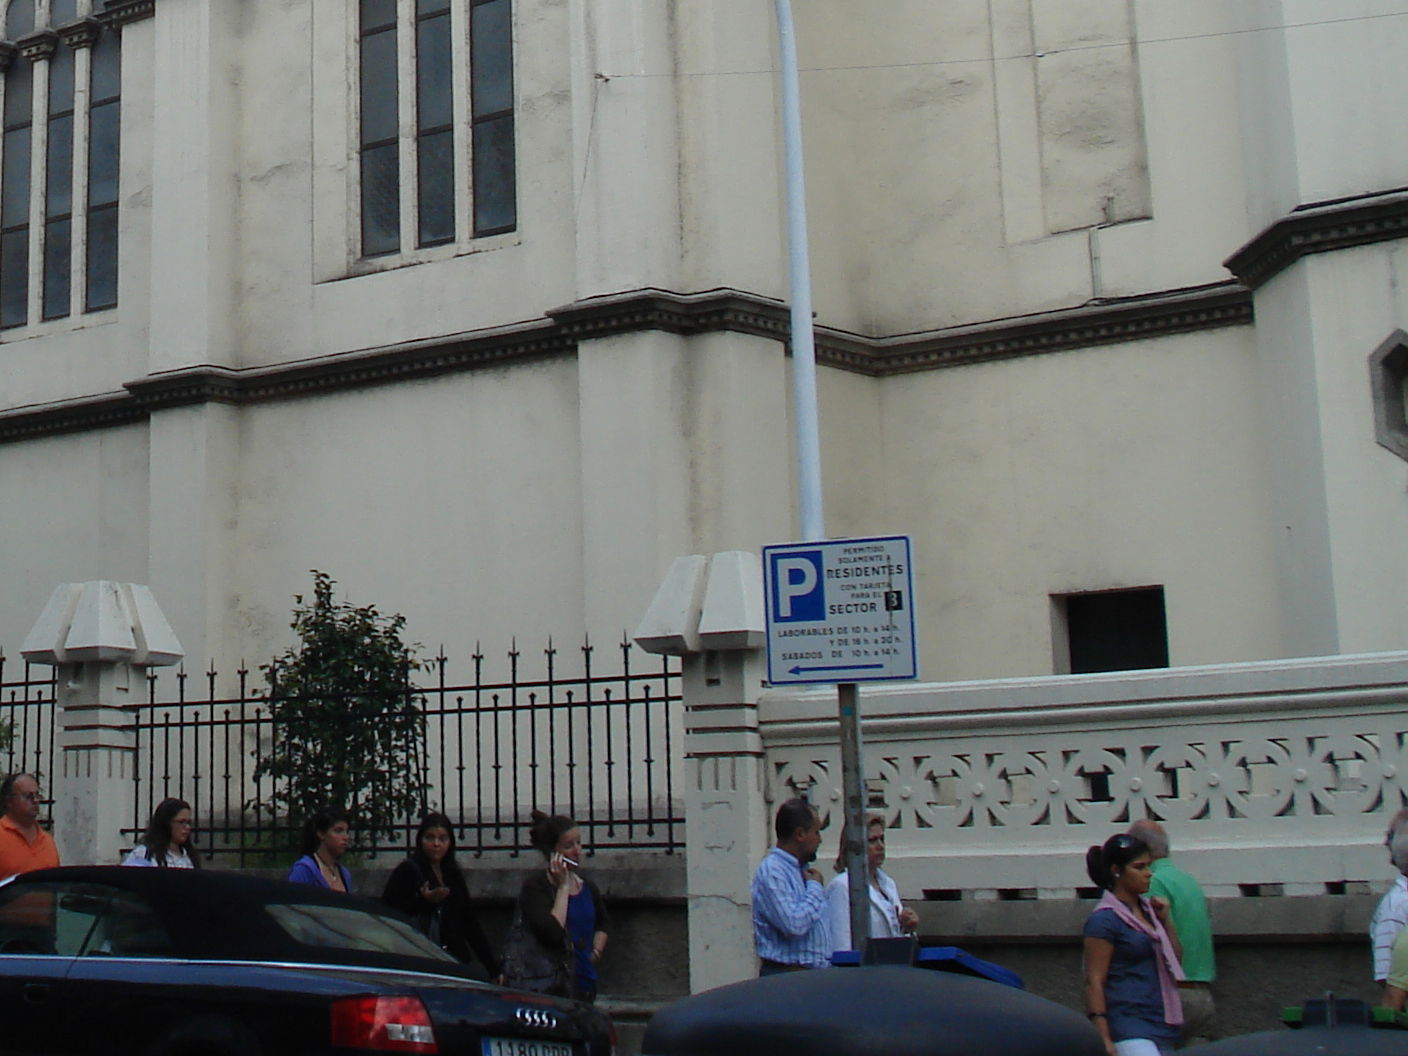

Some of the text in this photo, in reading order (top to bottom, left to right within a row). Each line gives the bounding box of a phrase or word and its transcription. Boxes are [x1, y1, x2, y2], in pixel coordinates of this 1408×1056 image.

[838, 555, 882, 564] SOLAMENTE
[826, 564, 904, 579] RESIDENTES
[777, 557, 818, 618] P
[860, 582, 892, 590] TARJETA
[829, 602, 877, 615] SECTOR
[778, 627, 834, 638] LABORABLES
[837, 626, 848, 634] DE
[838, 638, 848, 646] DE
[782, 651, 824, 660] SABADOS
[832, 650, 842, 658] DE
